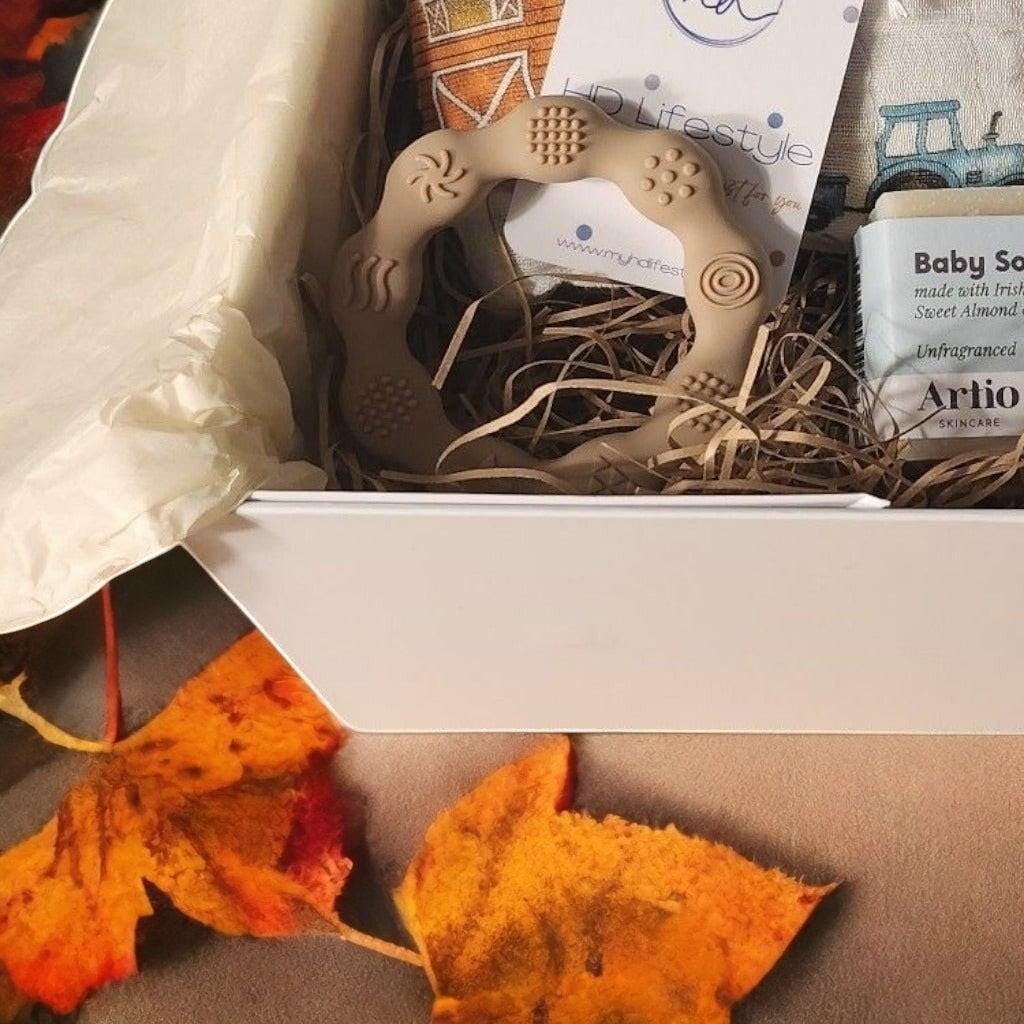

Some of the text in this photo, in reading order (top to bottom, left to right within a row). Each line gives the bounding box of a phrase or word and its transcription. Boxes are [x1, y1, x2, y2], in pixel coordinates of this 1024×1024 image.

[563, 77, 814, 166] HD Lifestyle
[914, 249, 985, 280] Baby
[914, 281, 954, 299] made
[957, 280, 990, 298] with
[914, 304, 957, 319] Sweet
[960, 300, 1018, 319] Almond
[916, 340, 1018, 361] Unfragranced
[917, 378, 1020, 412] Artio
[938, 417, 1002, 429] SKINCARE
